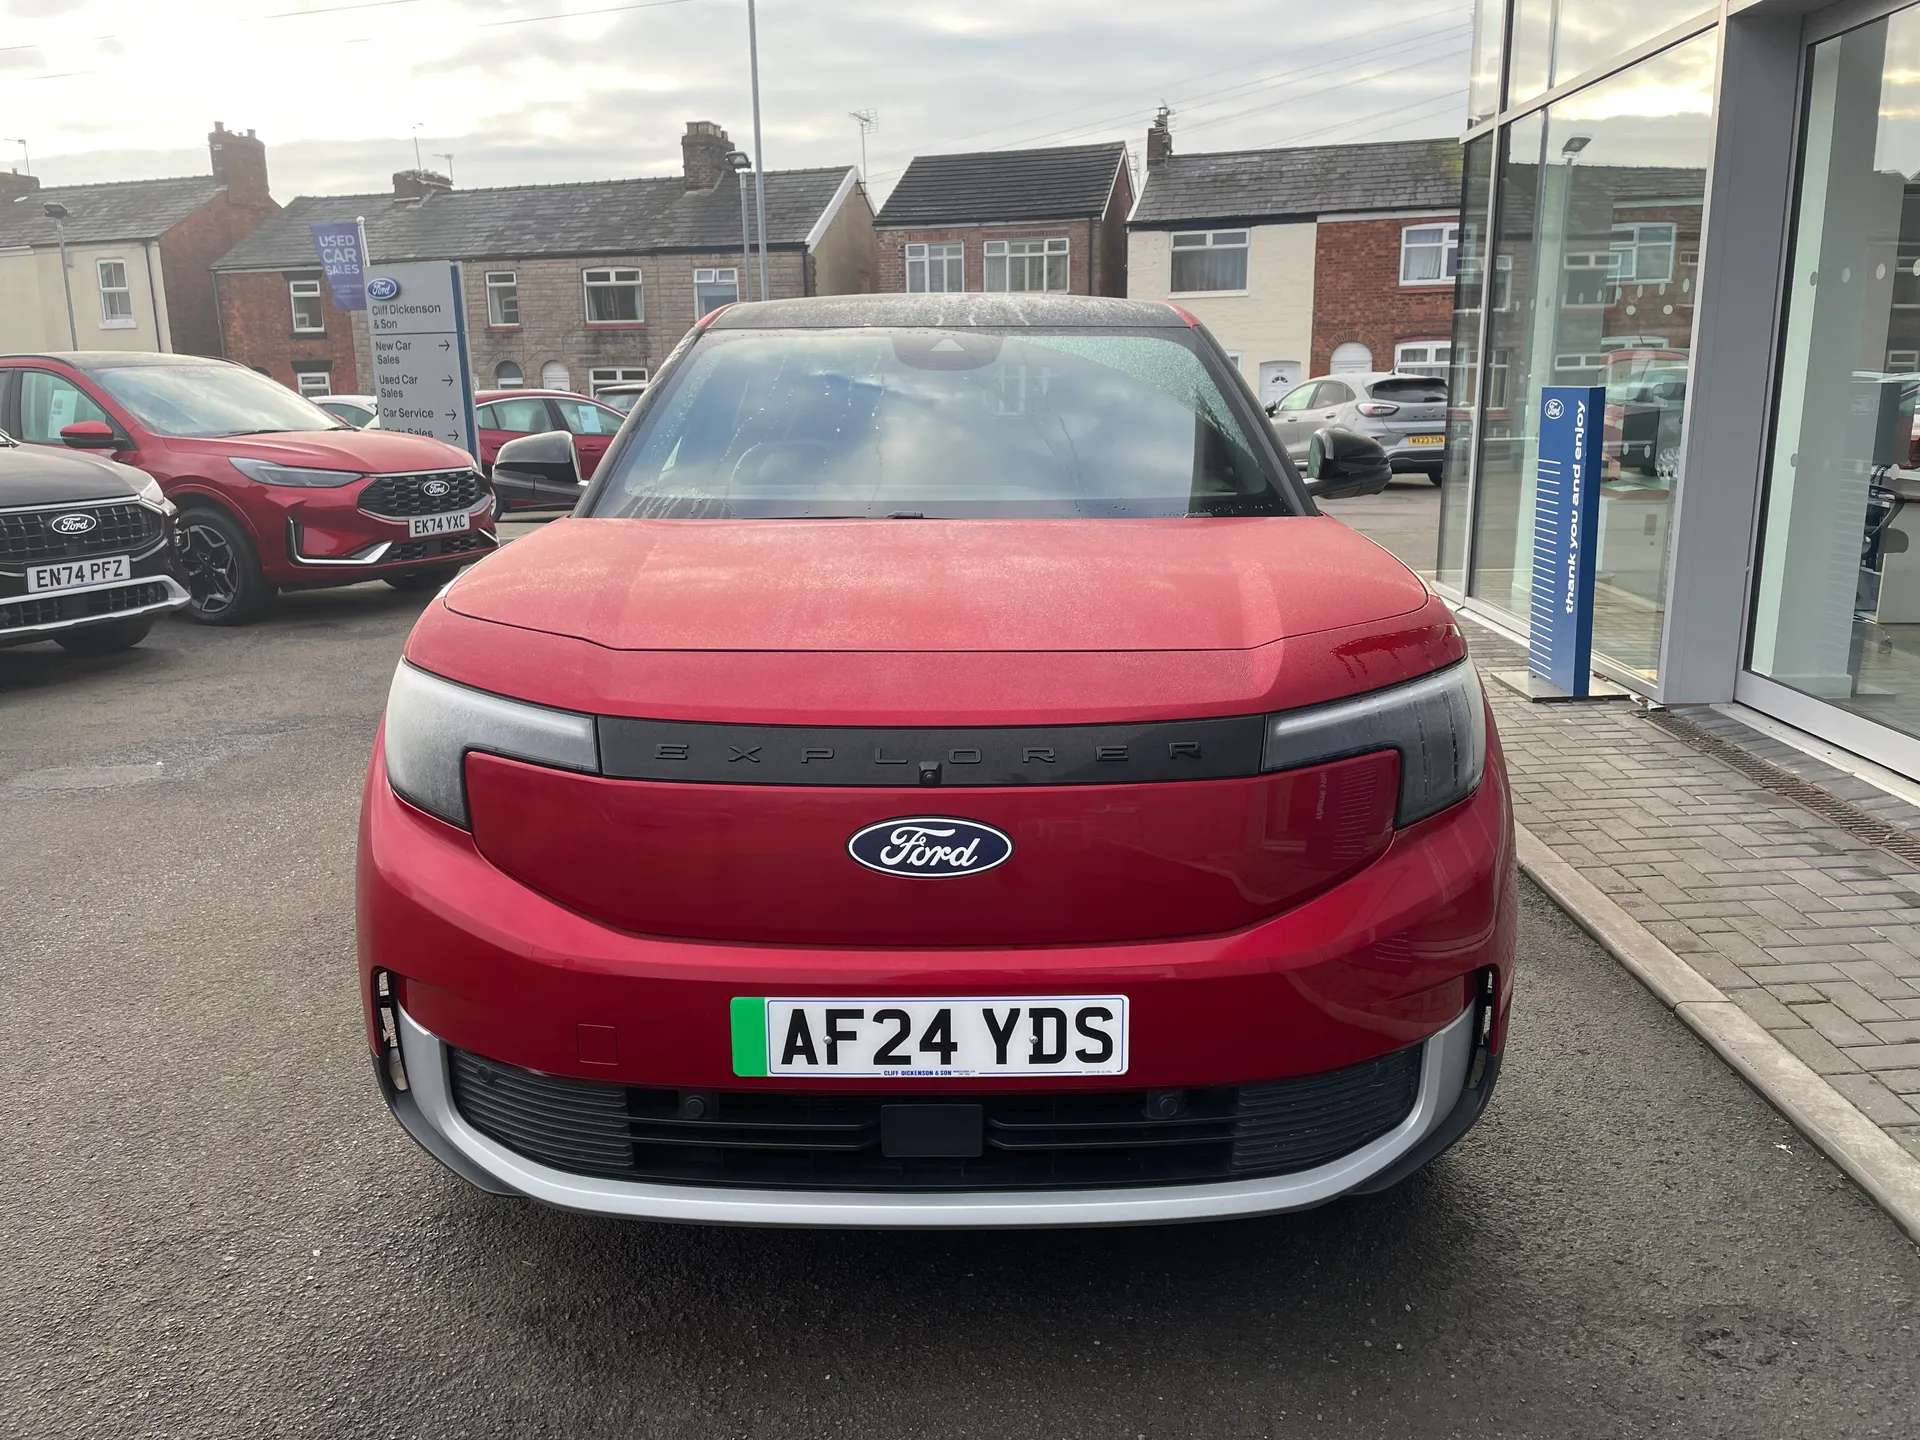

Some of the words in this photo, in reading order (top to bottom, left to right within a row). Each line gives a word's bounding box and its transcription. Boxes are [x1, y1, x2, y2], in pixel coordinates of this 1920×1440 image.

[319, 234, 356, 248] USED
[322, 247, 358, 263] CAR
[325, 264, 360, 276] SALES
[371, 304, 388, 316] Cliff
[389, 303, 441, 315] Dickenson
[373, 320, 380, 329] &
[380, 319, 398, 329] Son
[375, 341, 394, 352] New
[395, 340, 412, 351] Car
[377, 354, 400, 365] Sales
[379, 374, 400, 385] Used
[401, 374, 418, 385] Car
[381, 387, 404, 399] Sales
[383, 407, 397, 418] Car
[398, 407, 434, 418] Service
[1575, 400, 1586, 460] enjoy
[1572, 464, 1581, 506] and
[61, 517, 89, 531] Ford
[414, 517, 444, 535] EK74
[446, 514, 466, 530] YXC
[1569, 510, 1579, 549] you
[36, 565, 86, 589] EN74
[90, 559, 123, 581] PFZ
[1565, 553, 1577, 614] thank
[653, 739, 1204, 766] EXPLORER
[879, 826, 982, 868] Ford
[780, 1007, 958, 1066] AF24
[982, 1006, 1114, 1065] YDS
